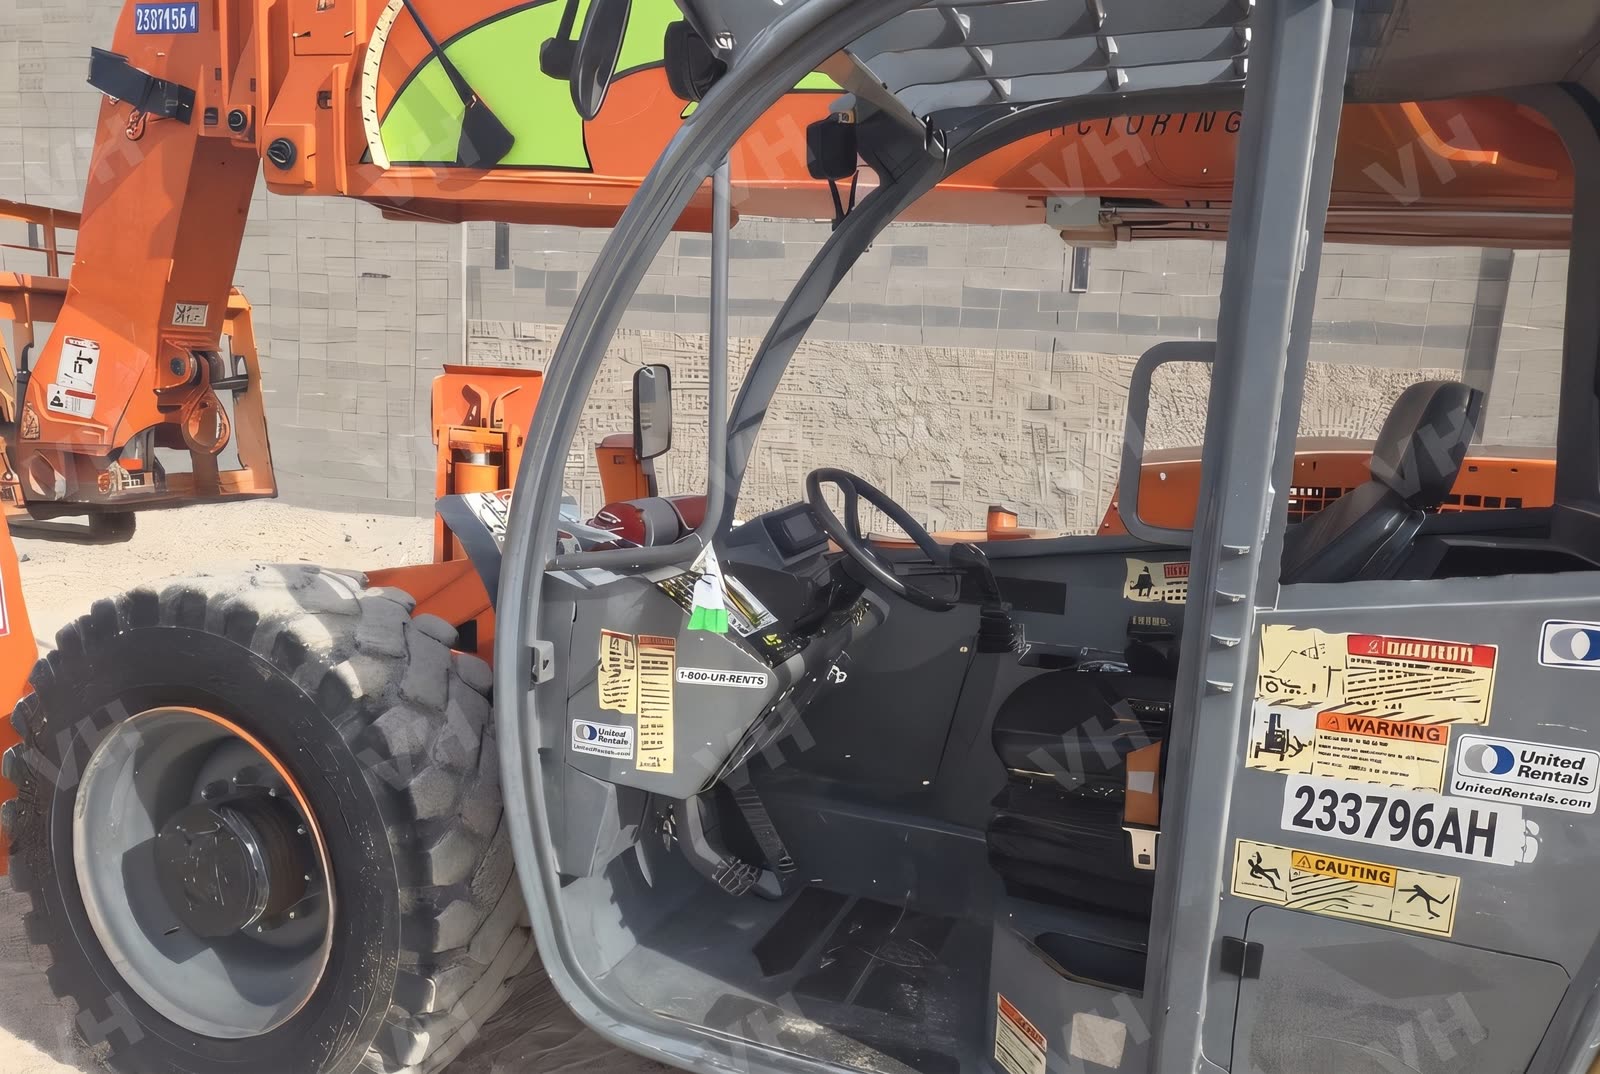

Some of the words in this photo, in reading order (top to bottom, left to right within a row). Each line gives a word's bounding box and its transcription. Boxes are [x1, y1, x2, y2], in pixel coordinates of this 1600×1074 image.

[679, 670, 765, 686] 1-800-UR-RENTS
[1347, 717, 1441, 742] WARNING
[1520, 750, 1586, 771] United
[1517, 764, 1590, 787] Rentals
[1455, 780, 1592, 809] UnitedRentals.com
[1292, 784, 1499, 858] 233796AH
[1314, 859, 1391, 885] CAUTING
